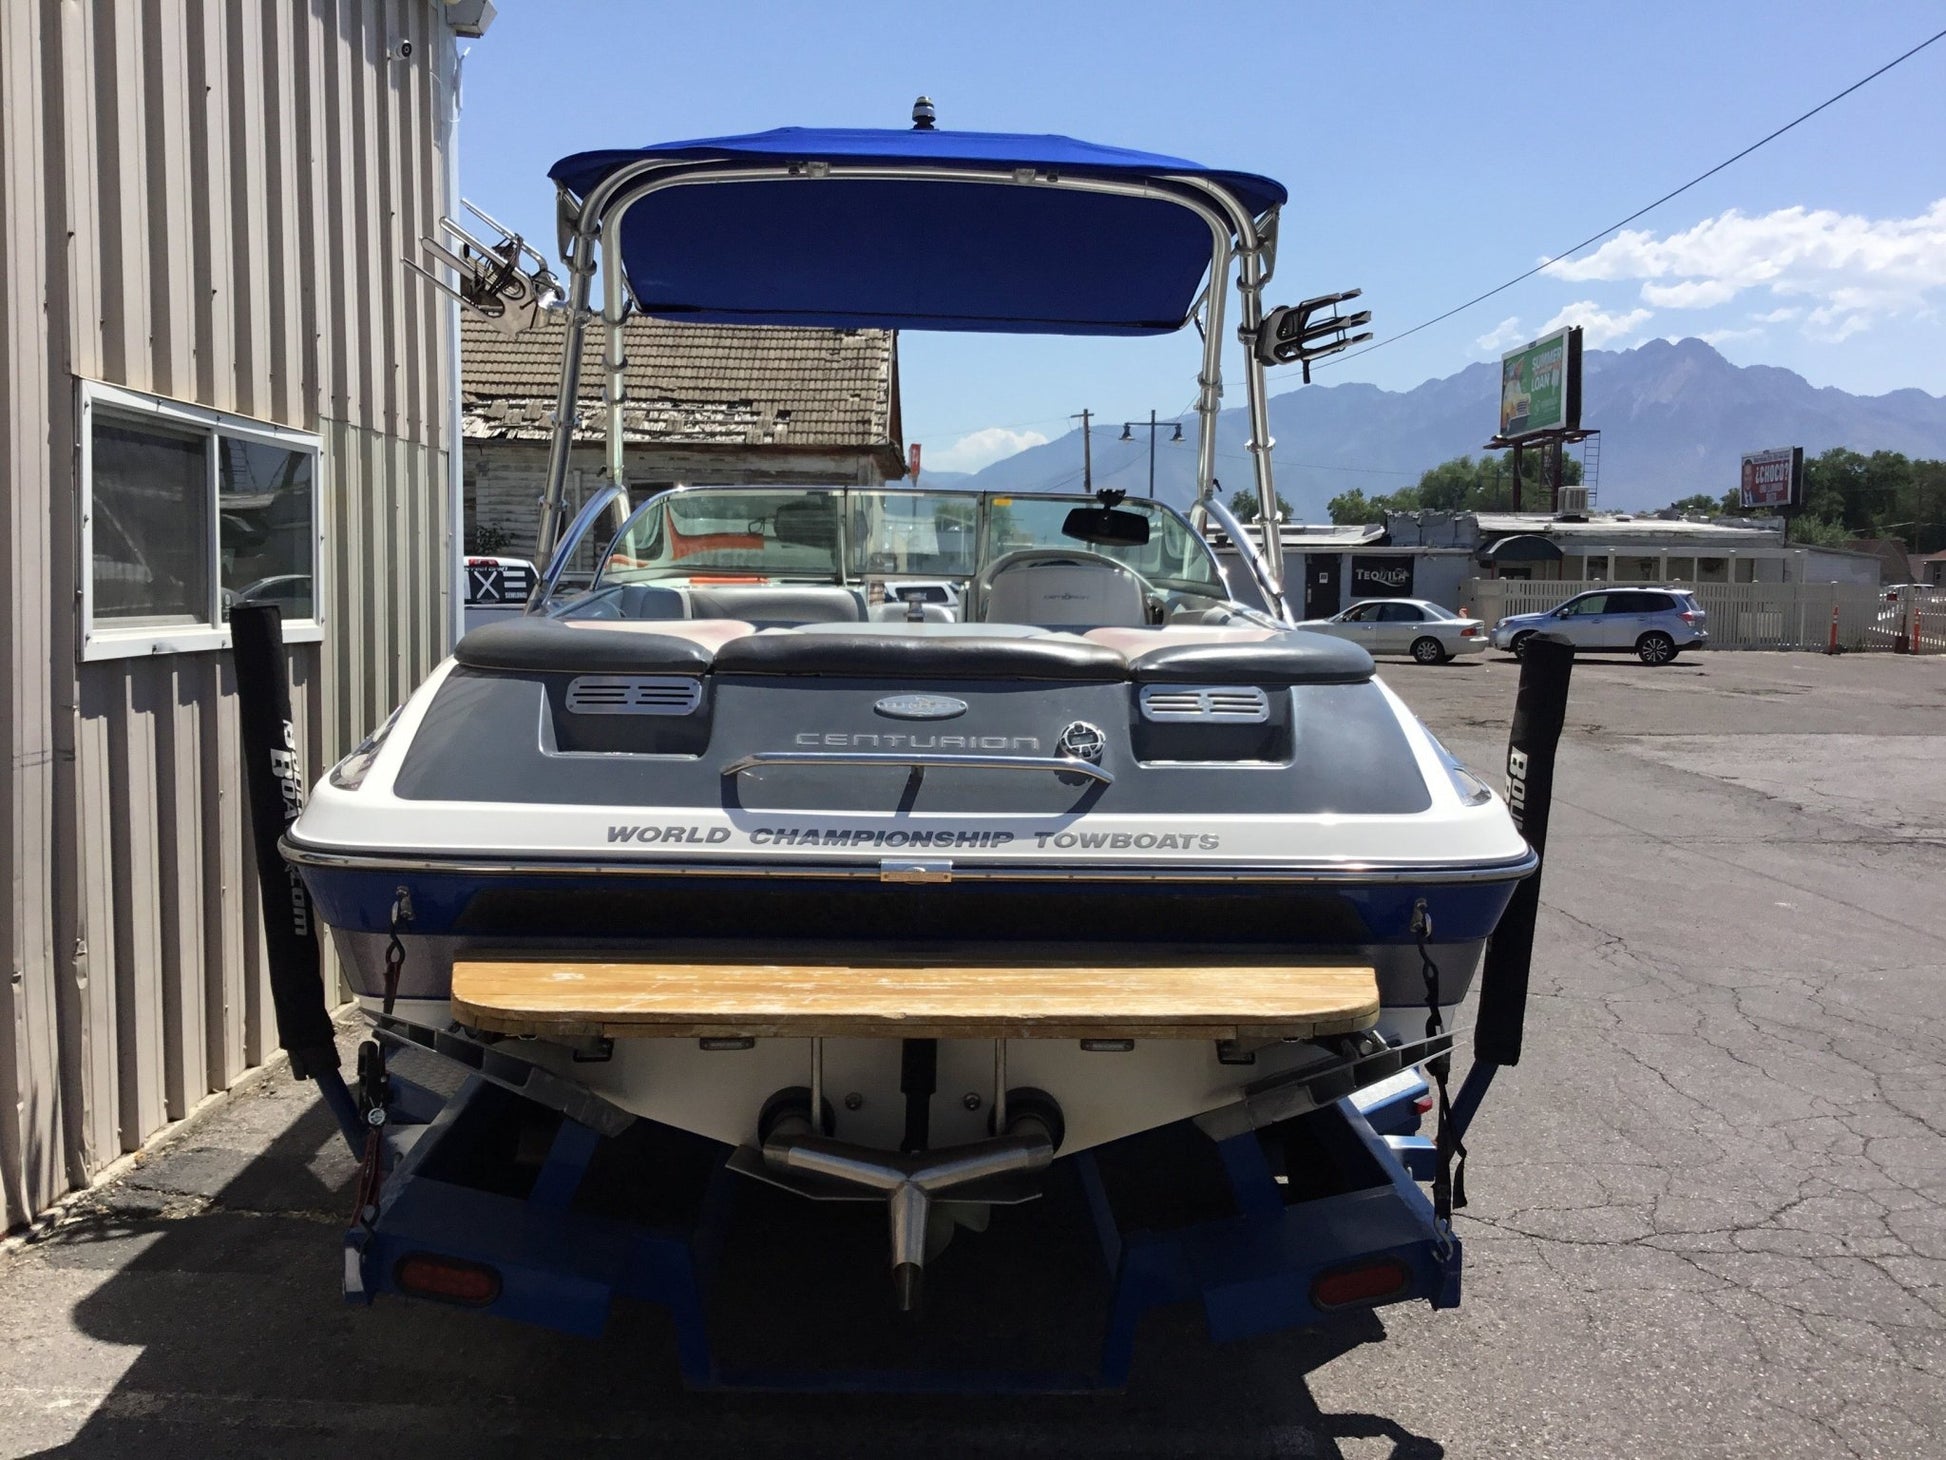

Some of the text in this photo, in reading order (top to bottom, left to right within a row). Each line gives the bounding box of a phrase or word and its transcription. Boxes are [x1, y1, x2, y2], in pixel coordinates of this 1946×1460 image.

[1531, 372, 1550, 393] LOAN
[796, 733, 1040, 750] CENTURION
[607, 826, 1220, 850] WORLD CHAMPIONSHIP TOWBOATS
